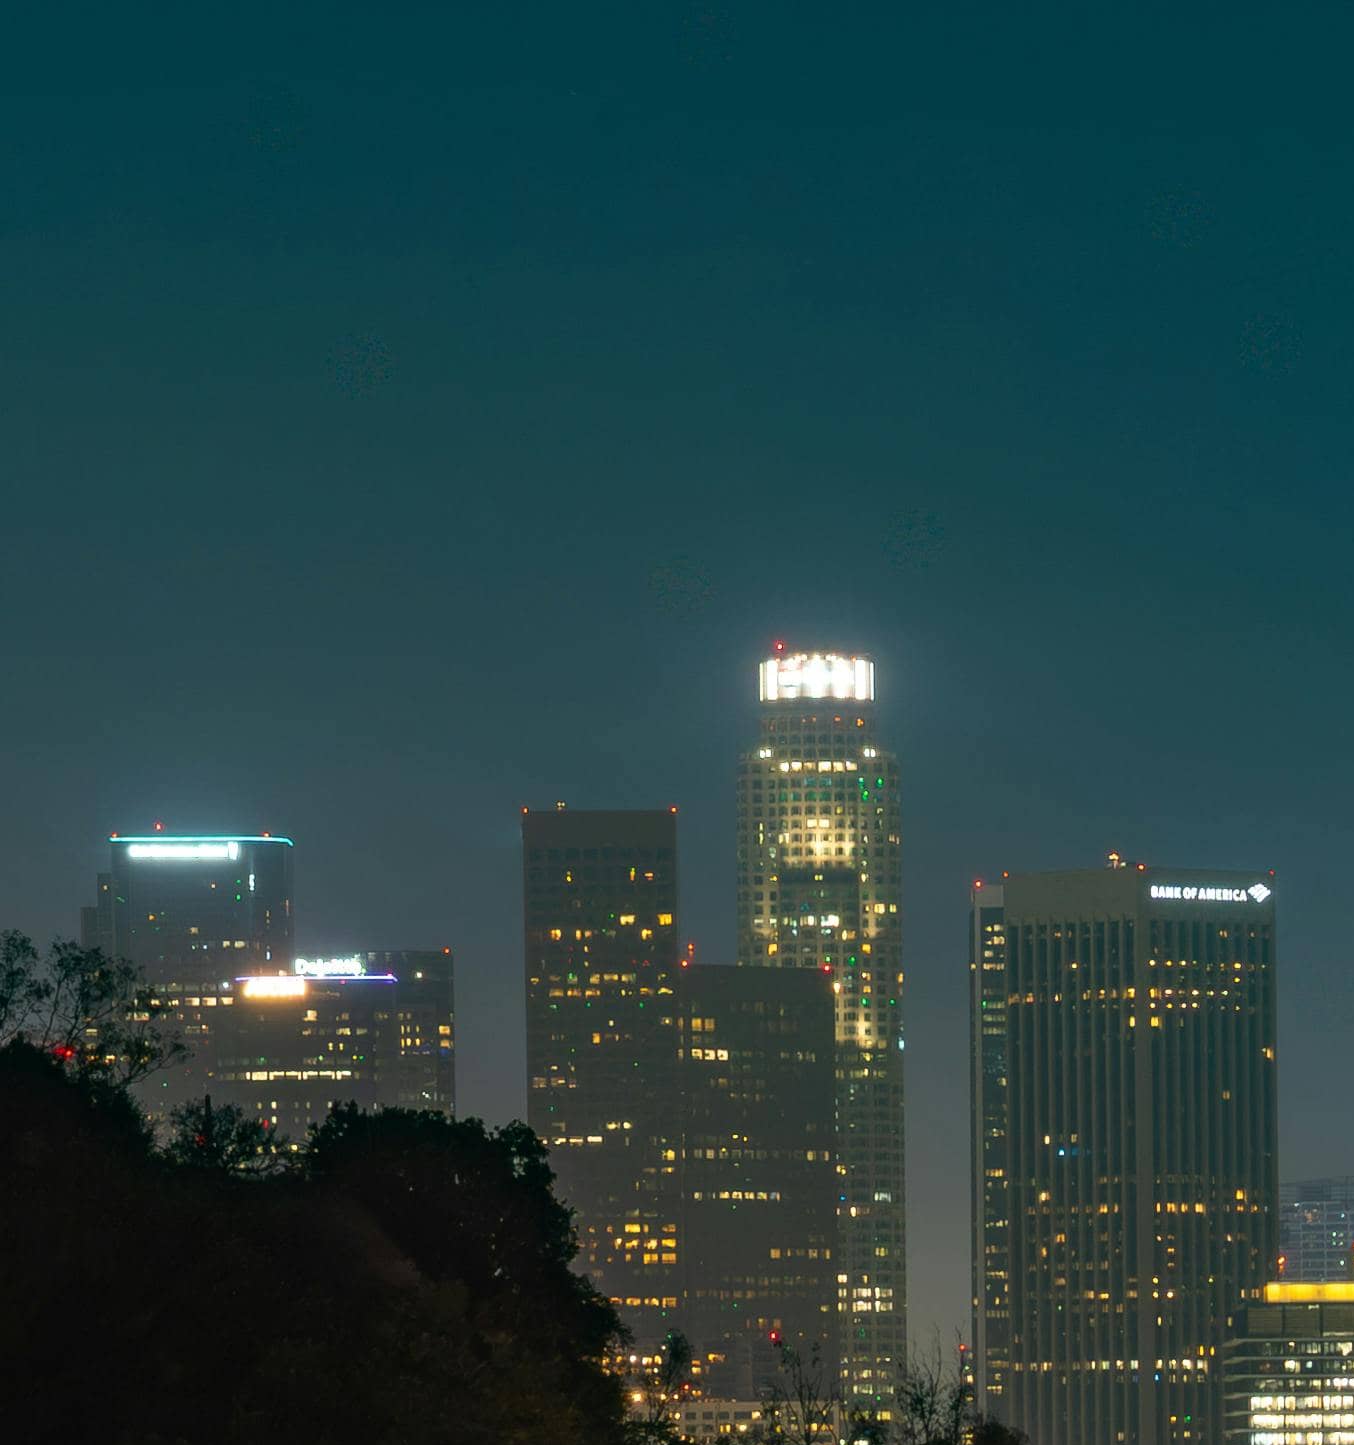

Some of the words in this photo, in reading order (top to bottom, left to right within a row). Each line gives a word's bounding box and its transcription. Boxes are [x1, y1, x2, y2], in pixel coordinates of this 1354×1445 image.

[1150, 885, 1182, 899] BANK
[1182, 886, 1198, 900] OF
[1198, 887, 1247, 902] AMERICA
